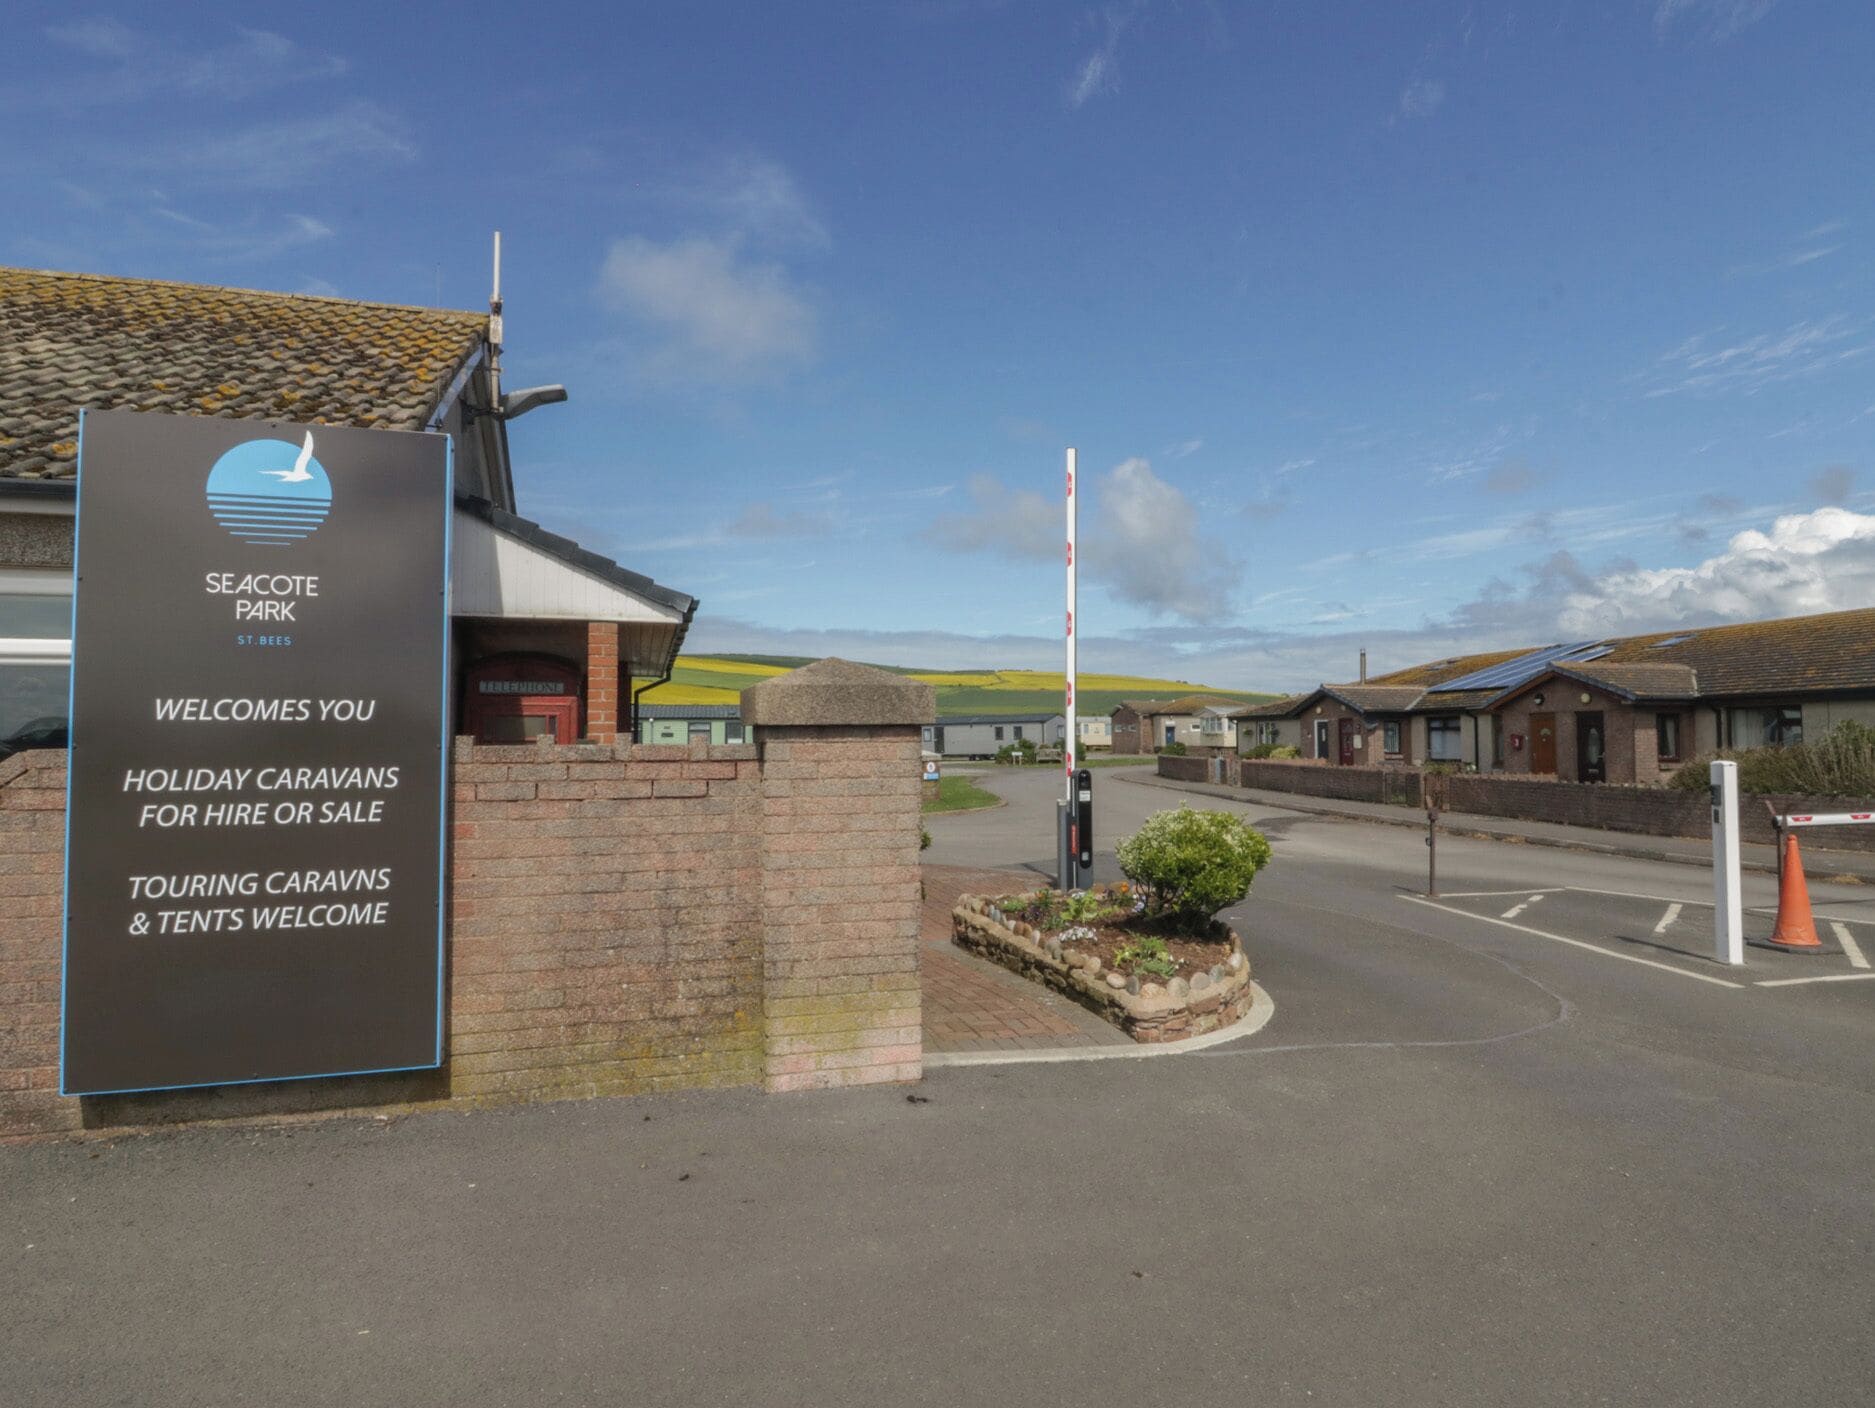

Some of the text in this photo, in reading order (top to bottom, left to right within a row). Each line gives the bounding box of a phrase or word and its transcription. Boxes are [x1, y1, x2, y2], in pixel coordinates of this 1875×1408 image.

[205, 572, 320, 597] SEACOTE
[235, 599, 296, 622] PARK
[155, 698, 376, 722] WELCOMES YOU
[123, 766, 400, 792] HOLIDAY CARAVANS
[139, 800, 385, 828] FOR HIRE OR SALE
[129, 868, 392, 900] TOURING CARAVNS
[128, 902, 389, 935] & TENTS WELCOME
